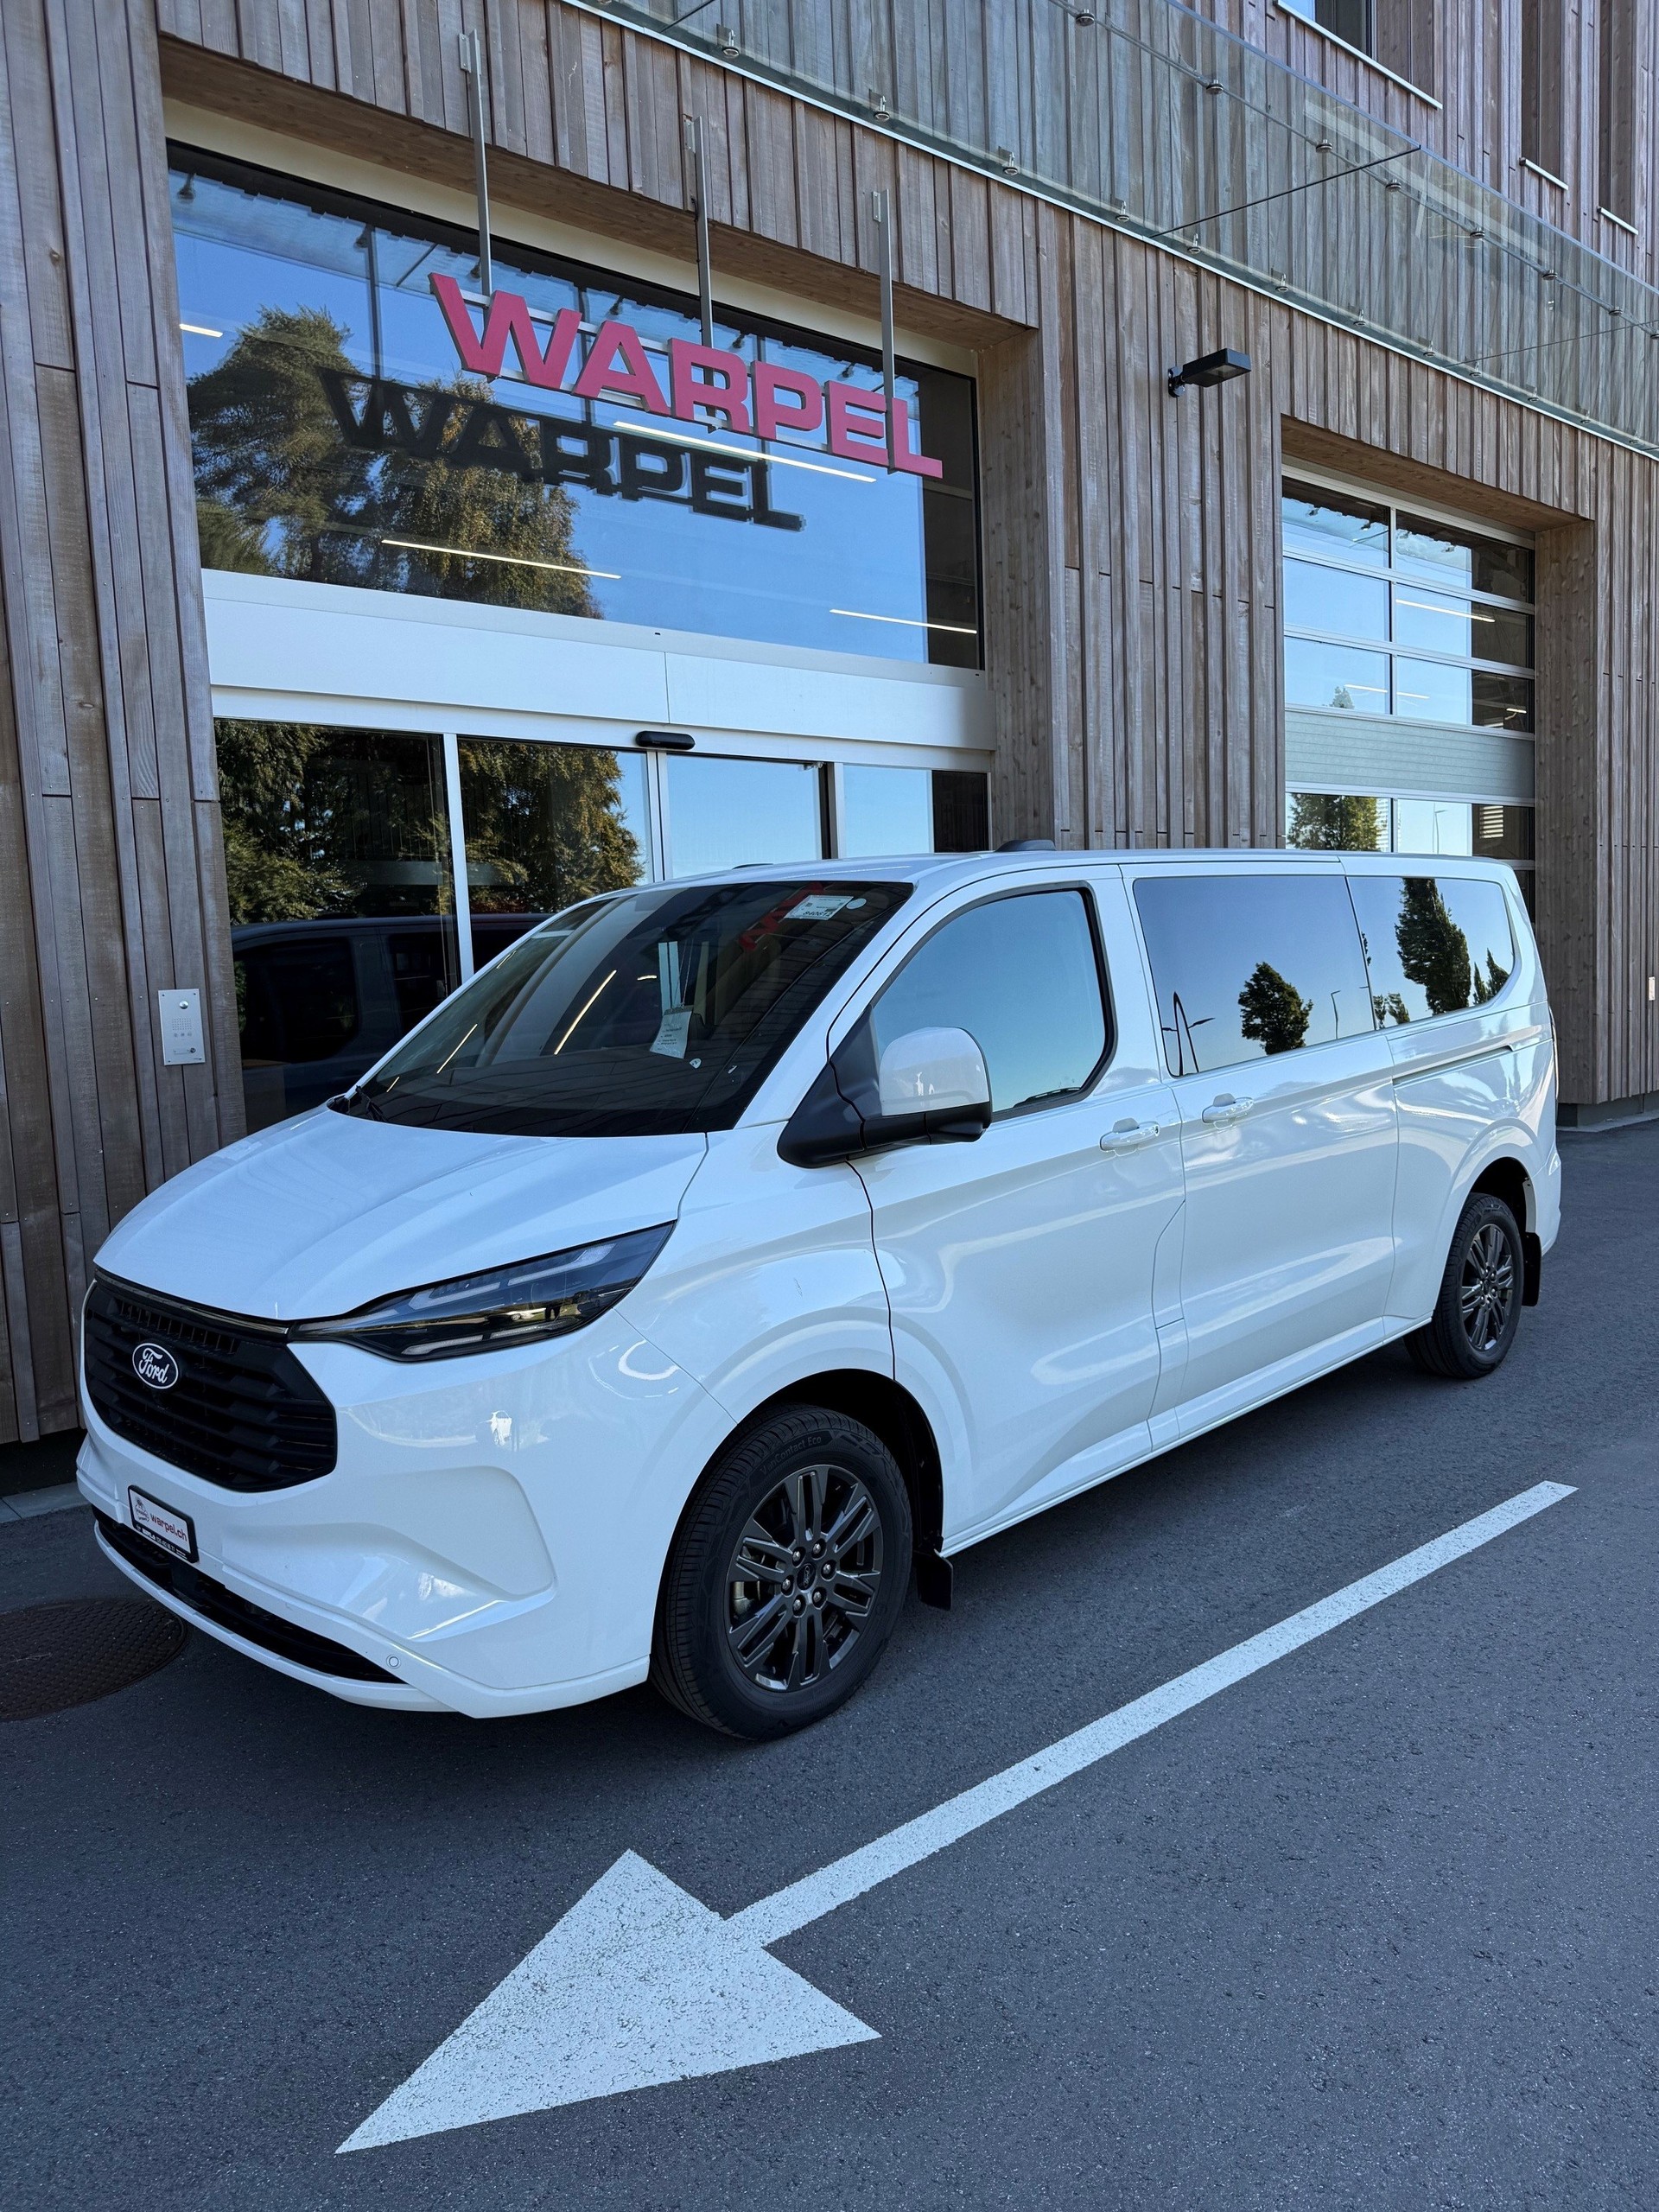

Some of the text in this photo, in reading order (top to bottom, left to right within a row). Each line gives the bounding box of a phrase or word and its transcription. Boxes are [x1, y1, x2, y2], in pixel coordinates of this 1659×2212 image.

[429, 272, 944, 480] WARPEL
[316, 365, 805, 532] WARPEL
[138, 1347, 170, 1384] Ford
[760, 1435, 822, 1475] VanContact Eco
[149, 1513, 188, 1542] warpel.ch
